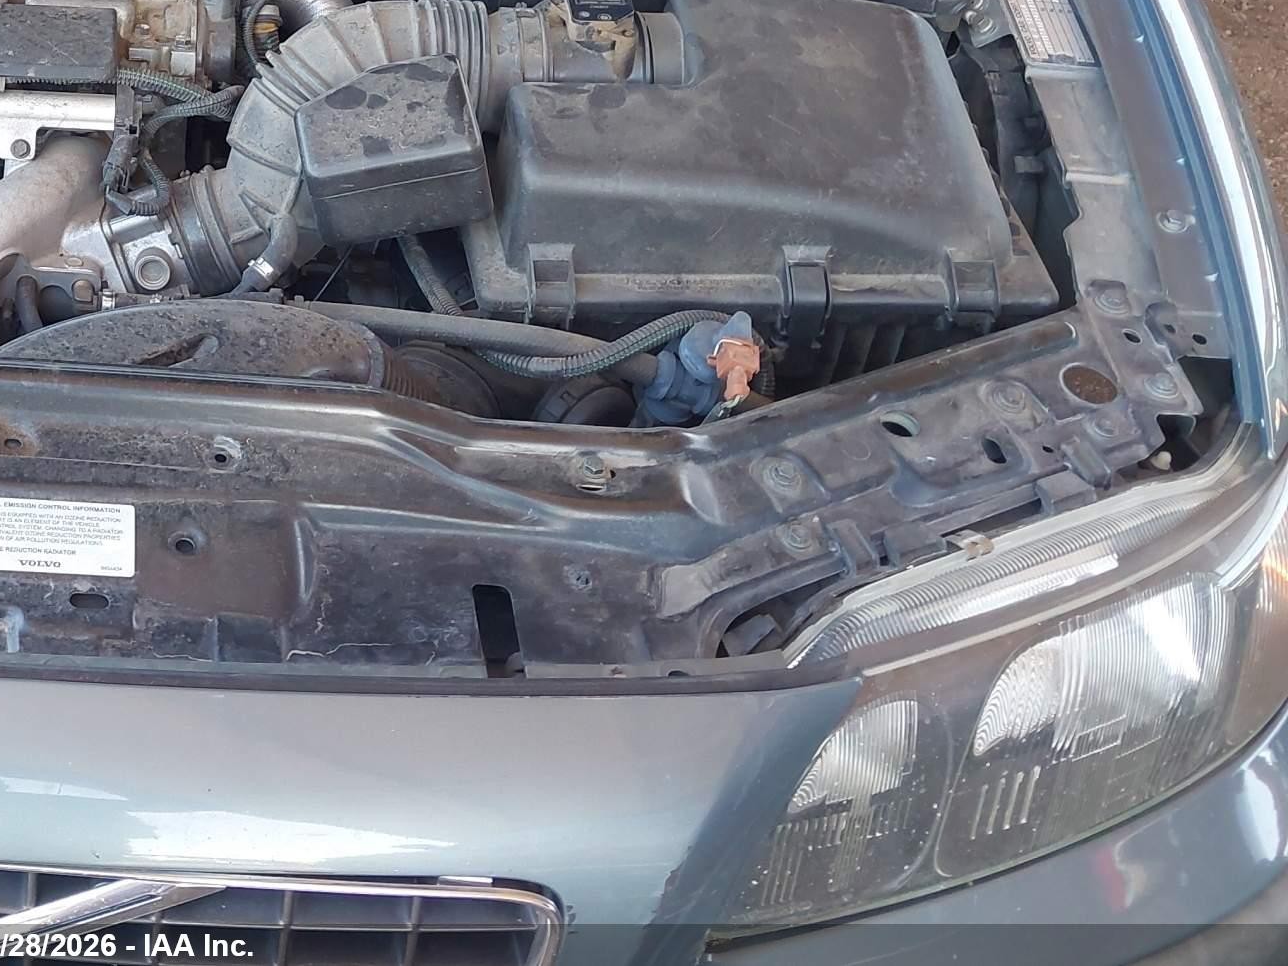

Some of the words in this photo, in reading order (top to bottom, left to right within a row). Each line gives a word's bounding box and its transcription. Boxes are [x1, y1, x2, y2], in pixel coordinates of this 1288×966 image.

[3, 501, 36, 509] EMISSION
[72, 505, 120, 513] INFORMATION
[18, 559, 60, 567] VOLVO
